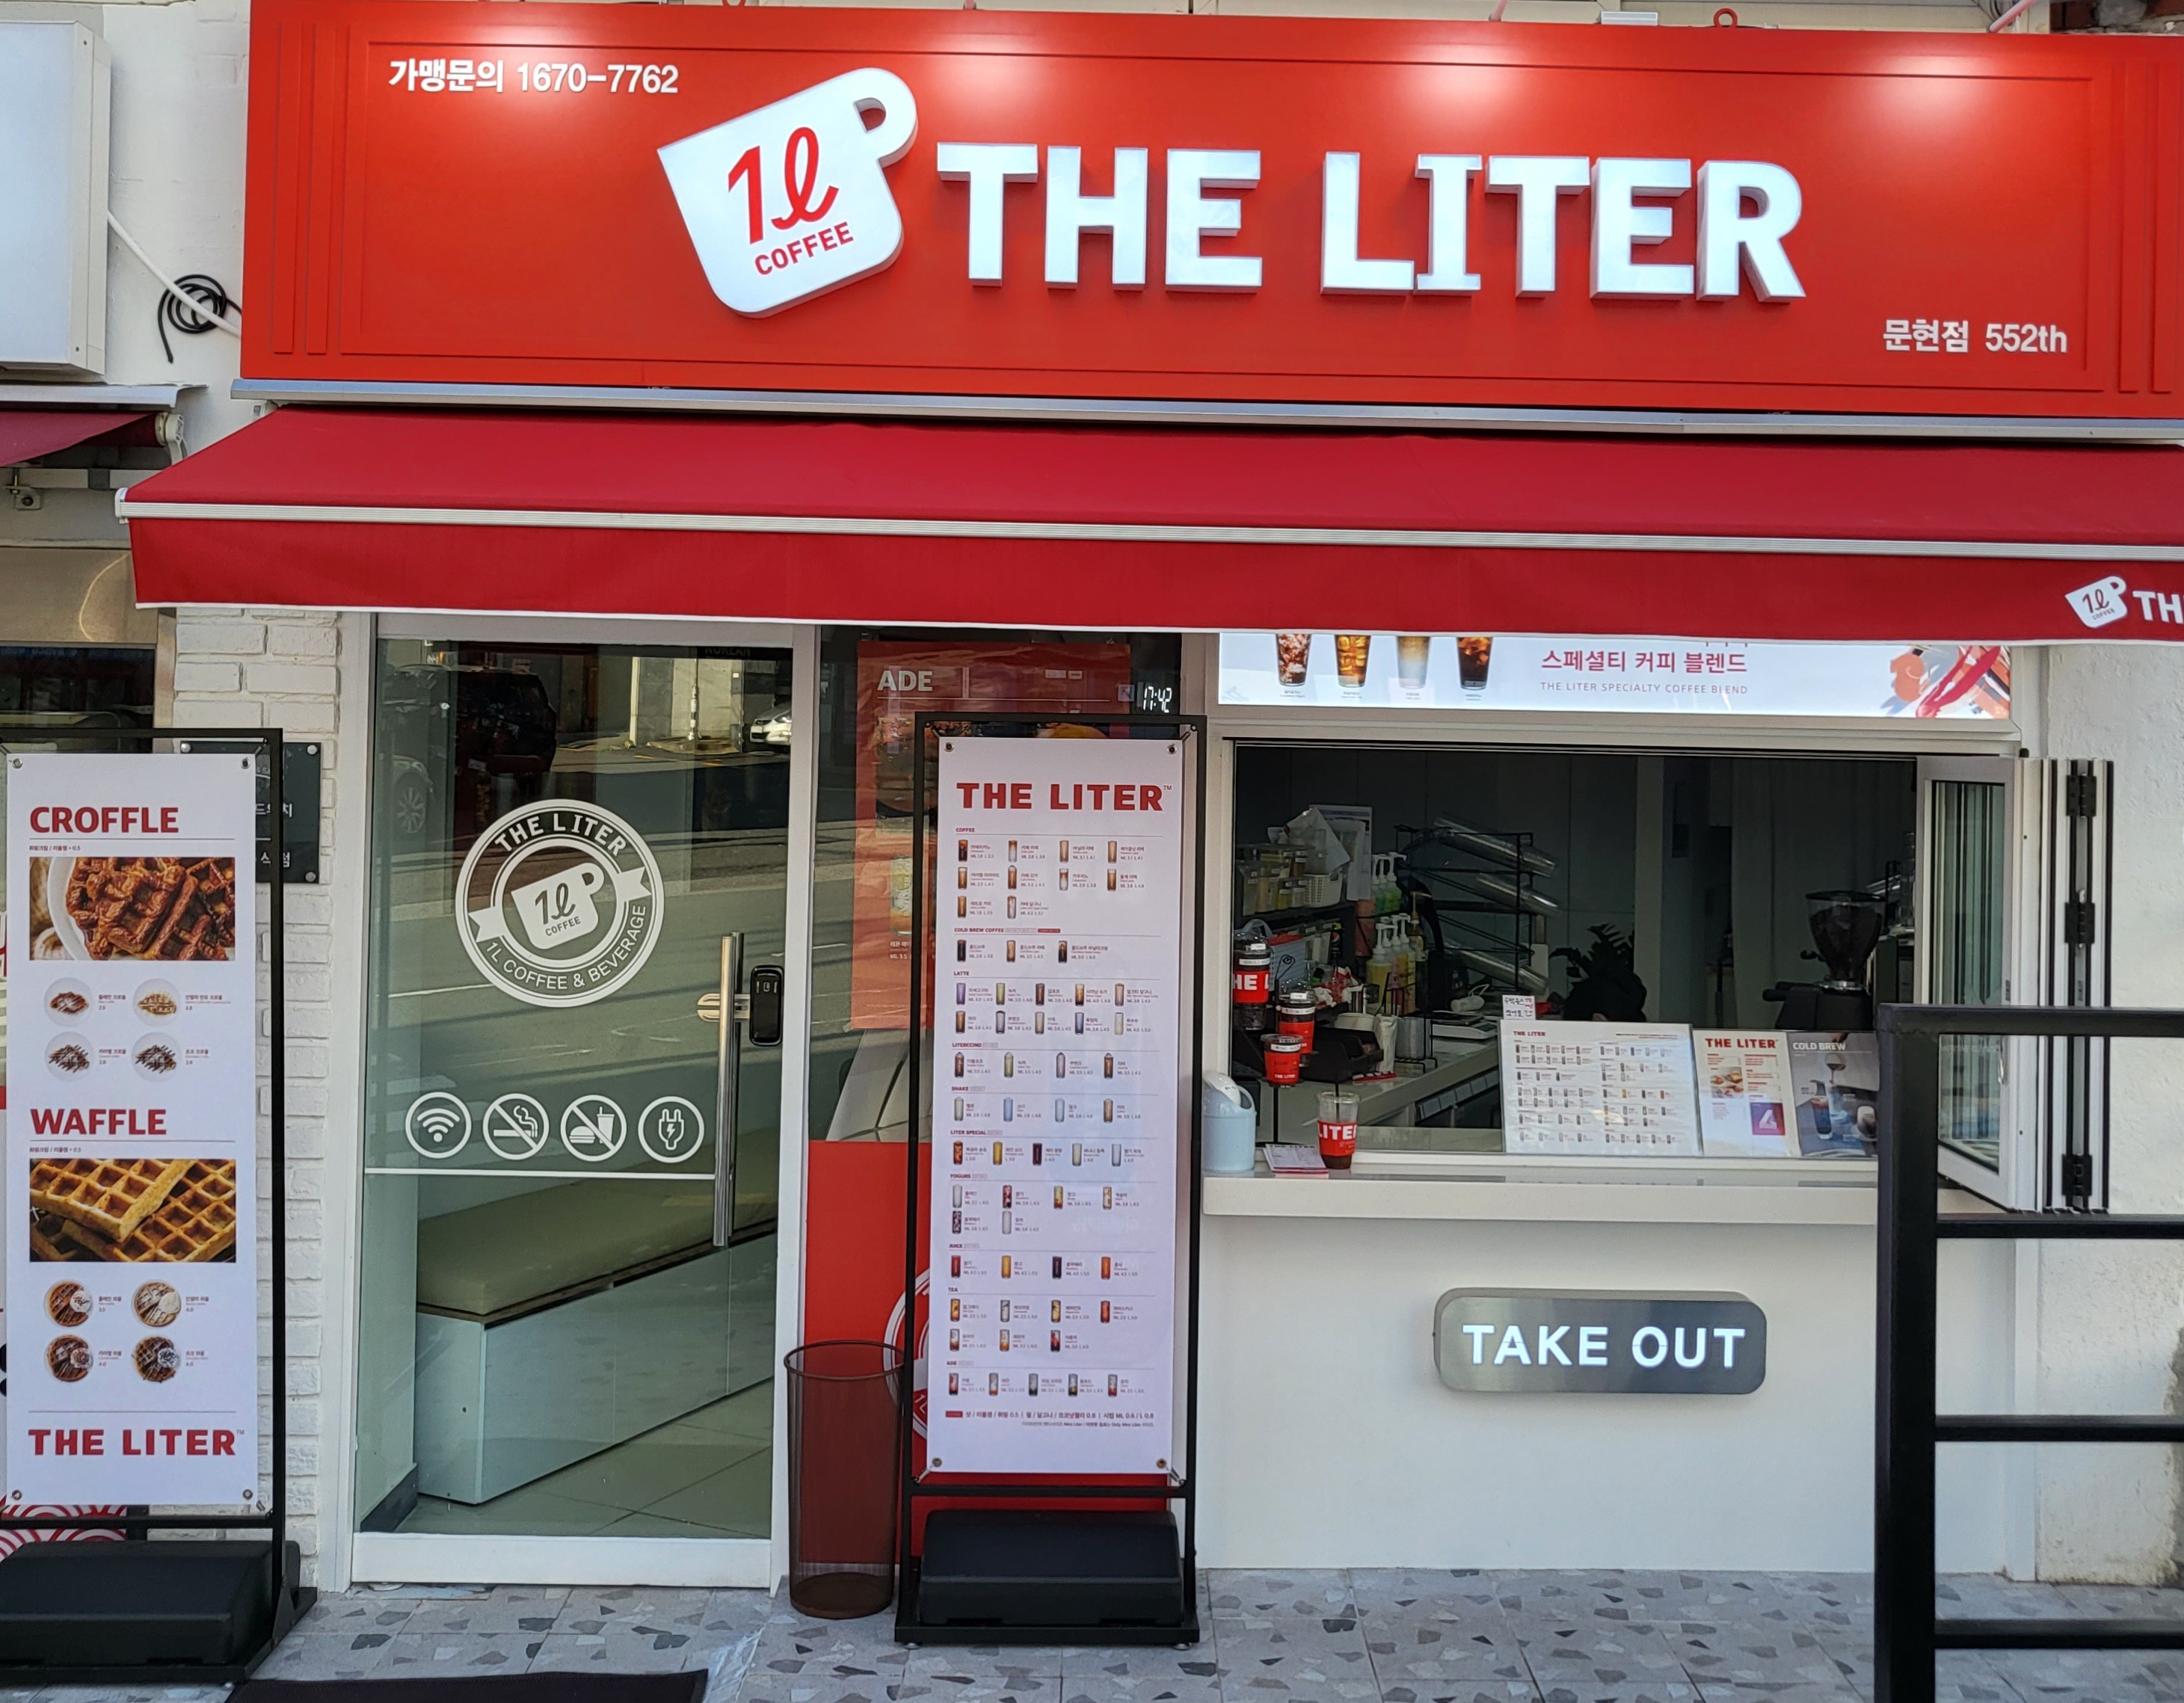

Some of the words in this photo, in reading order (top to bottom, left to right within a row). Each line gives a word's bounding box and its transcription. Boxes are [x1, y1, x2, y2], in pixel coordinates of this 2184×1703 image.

[389, 58, 503, 92] 가맹문의
[517, 62, 678, 93] 1670-7762
[937, 143, 1262, 292] THE
[1320, 152, 1806, 299] LITER
[754, 221, 854, 275] COFFEE
[1883, 319, 1969, 354] 문현점
[1985, 324, 2067, 354] 552th
[2132, 591, 2184, 624] TH
[1541, 650, 1625, 673] 스페셜티
[1635, 650, 1676, 673] 커피
[1683, 650, 1747, 673] 블렌드
[877, 671, 933, 691] ADE
[1541, 682, 1561, 691] THE
[1566, 683, 1597, 692] LITER
[1602, 683, 1661, 692] SPECIALTY
[1666, 685, 1706, 693] COFFEE
[1711, 686, 1747, 694] BLEND
[1142, 686, 1172, 713] 17:42
[956, 783, 1032, 809] THE
[1051, 783, 1163, 811] LITER
[30, 807, 179, 834] CROFFLE
[494, 816, 544, 852] THE
[553, 813, 627, 857] LITER
[544, 916, 581, 936] COFFEE
[486, 941, 505, 963] 1L
[503, 959, 567, 990] COFFEE
[573, 973, 585, 988] &
[588, 905, 646, 982] BEVERAGE
[1232, 973, 1258, 990] HE
[1705, 1038, 1732, 1048] THE
[1737, 1038, 1776, 1048] LITER
[1793, 1042, 1817, 1050] COLD
[1819, 1042, 1846, 1050] BREW
[31, 1109, 167, 1135] WAFFLE
[1462, 1324, 1608, 1368] TAKE
[1631, 1324, 1746, 1368] OUT
[28, 1429, 104, 1455] THE
[123, 1429, 236, 1456] LITER
